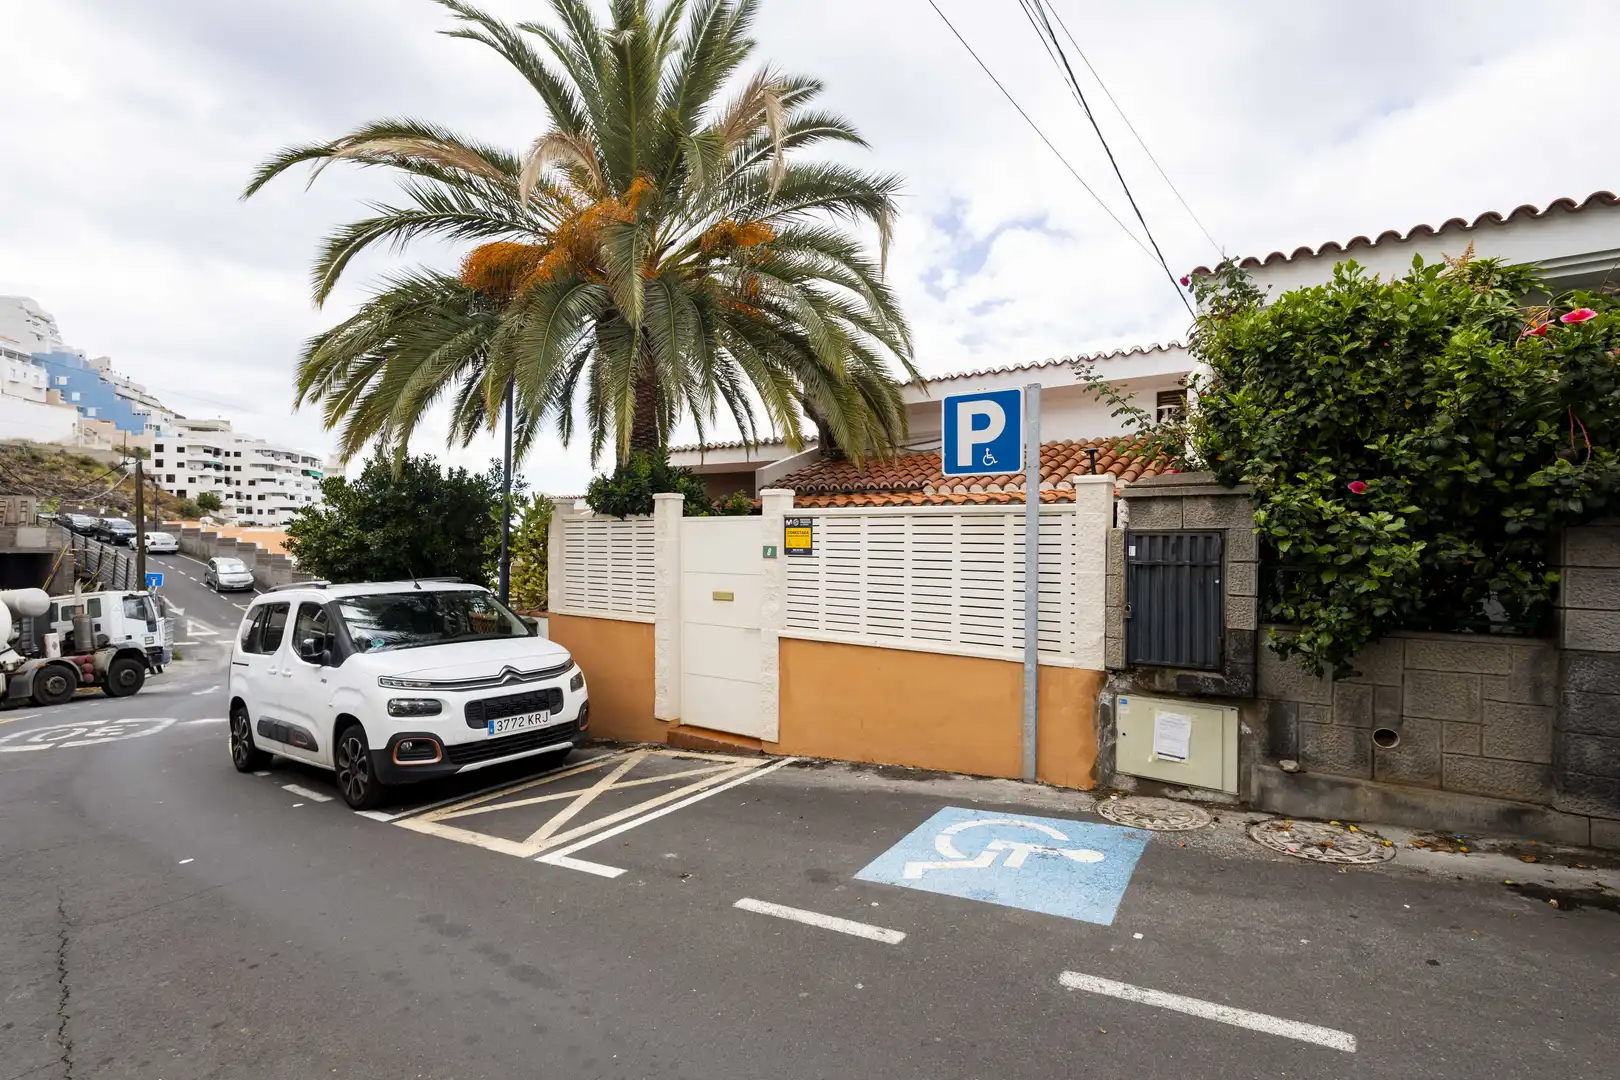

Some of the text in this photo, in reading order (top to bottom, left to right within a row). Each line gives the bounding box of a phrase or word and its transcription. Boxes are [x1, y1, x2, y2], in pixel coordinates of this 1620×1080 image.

[957, 400, 1006, 467] P
[497, 712, 548, 731] 3772 KRJ
